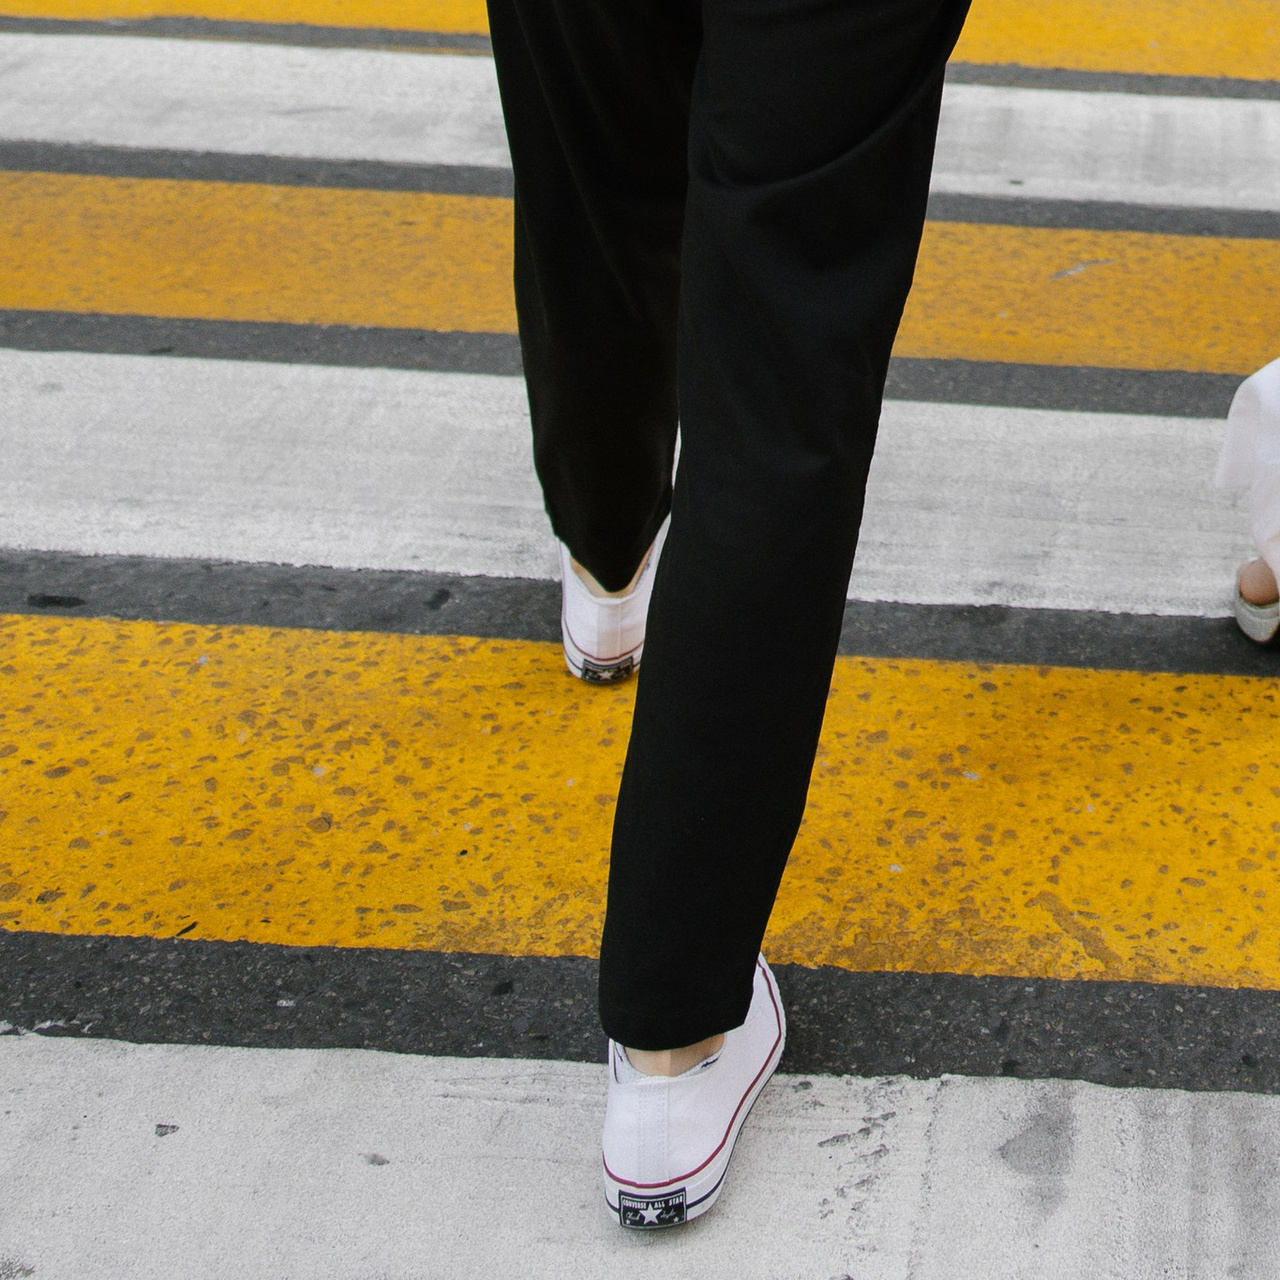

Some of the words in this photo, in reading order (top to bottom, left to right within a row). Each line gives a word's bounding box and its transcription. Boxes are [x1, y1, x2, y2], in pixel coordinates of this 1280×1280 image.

[622, 1198, 647, 1209] CONVERSE
[653, 1200, 666, 1209] ALL
[668, 1195, 683, 1206] STAR
